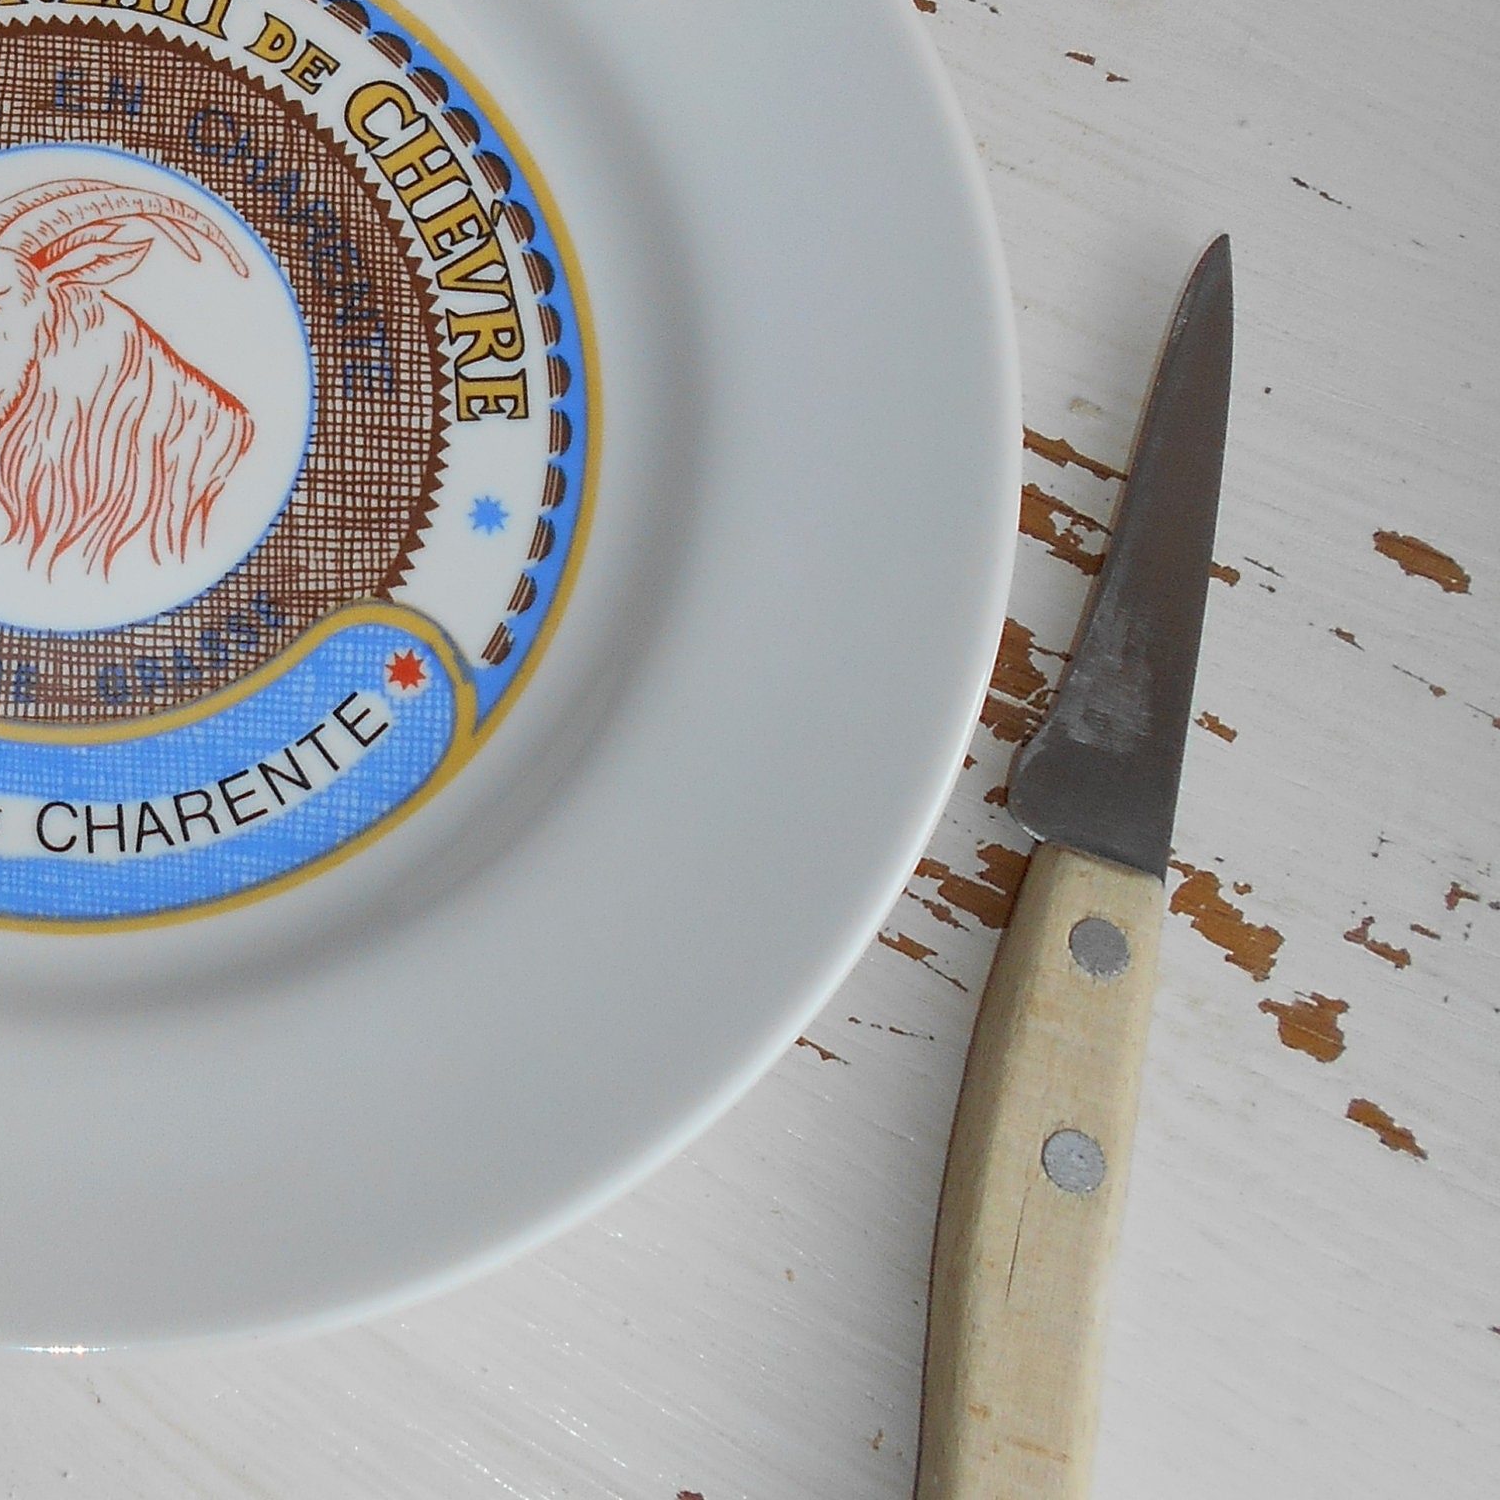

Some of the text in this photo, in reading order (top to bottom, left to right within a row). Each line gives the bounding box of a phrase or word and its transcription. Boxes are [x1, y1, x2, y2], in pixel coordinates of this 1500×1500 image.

[55, 71, 144, 120] EN
[186, 106, 394, 400] CHARENTE
[244, 12, 341, 95] DE
[344, 80, 531, 423] CHÈVRE
[36, 691, 389, 855] CHARENTE
